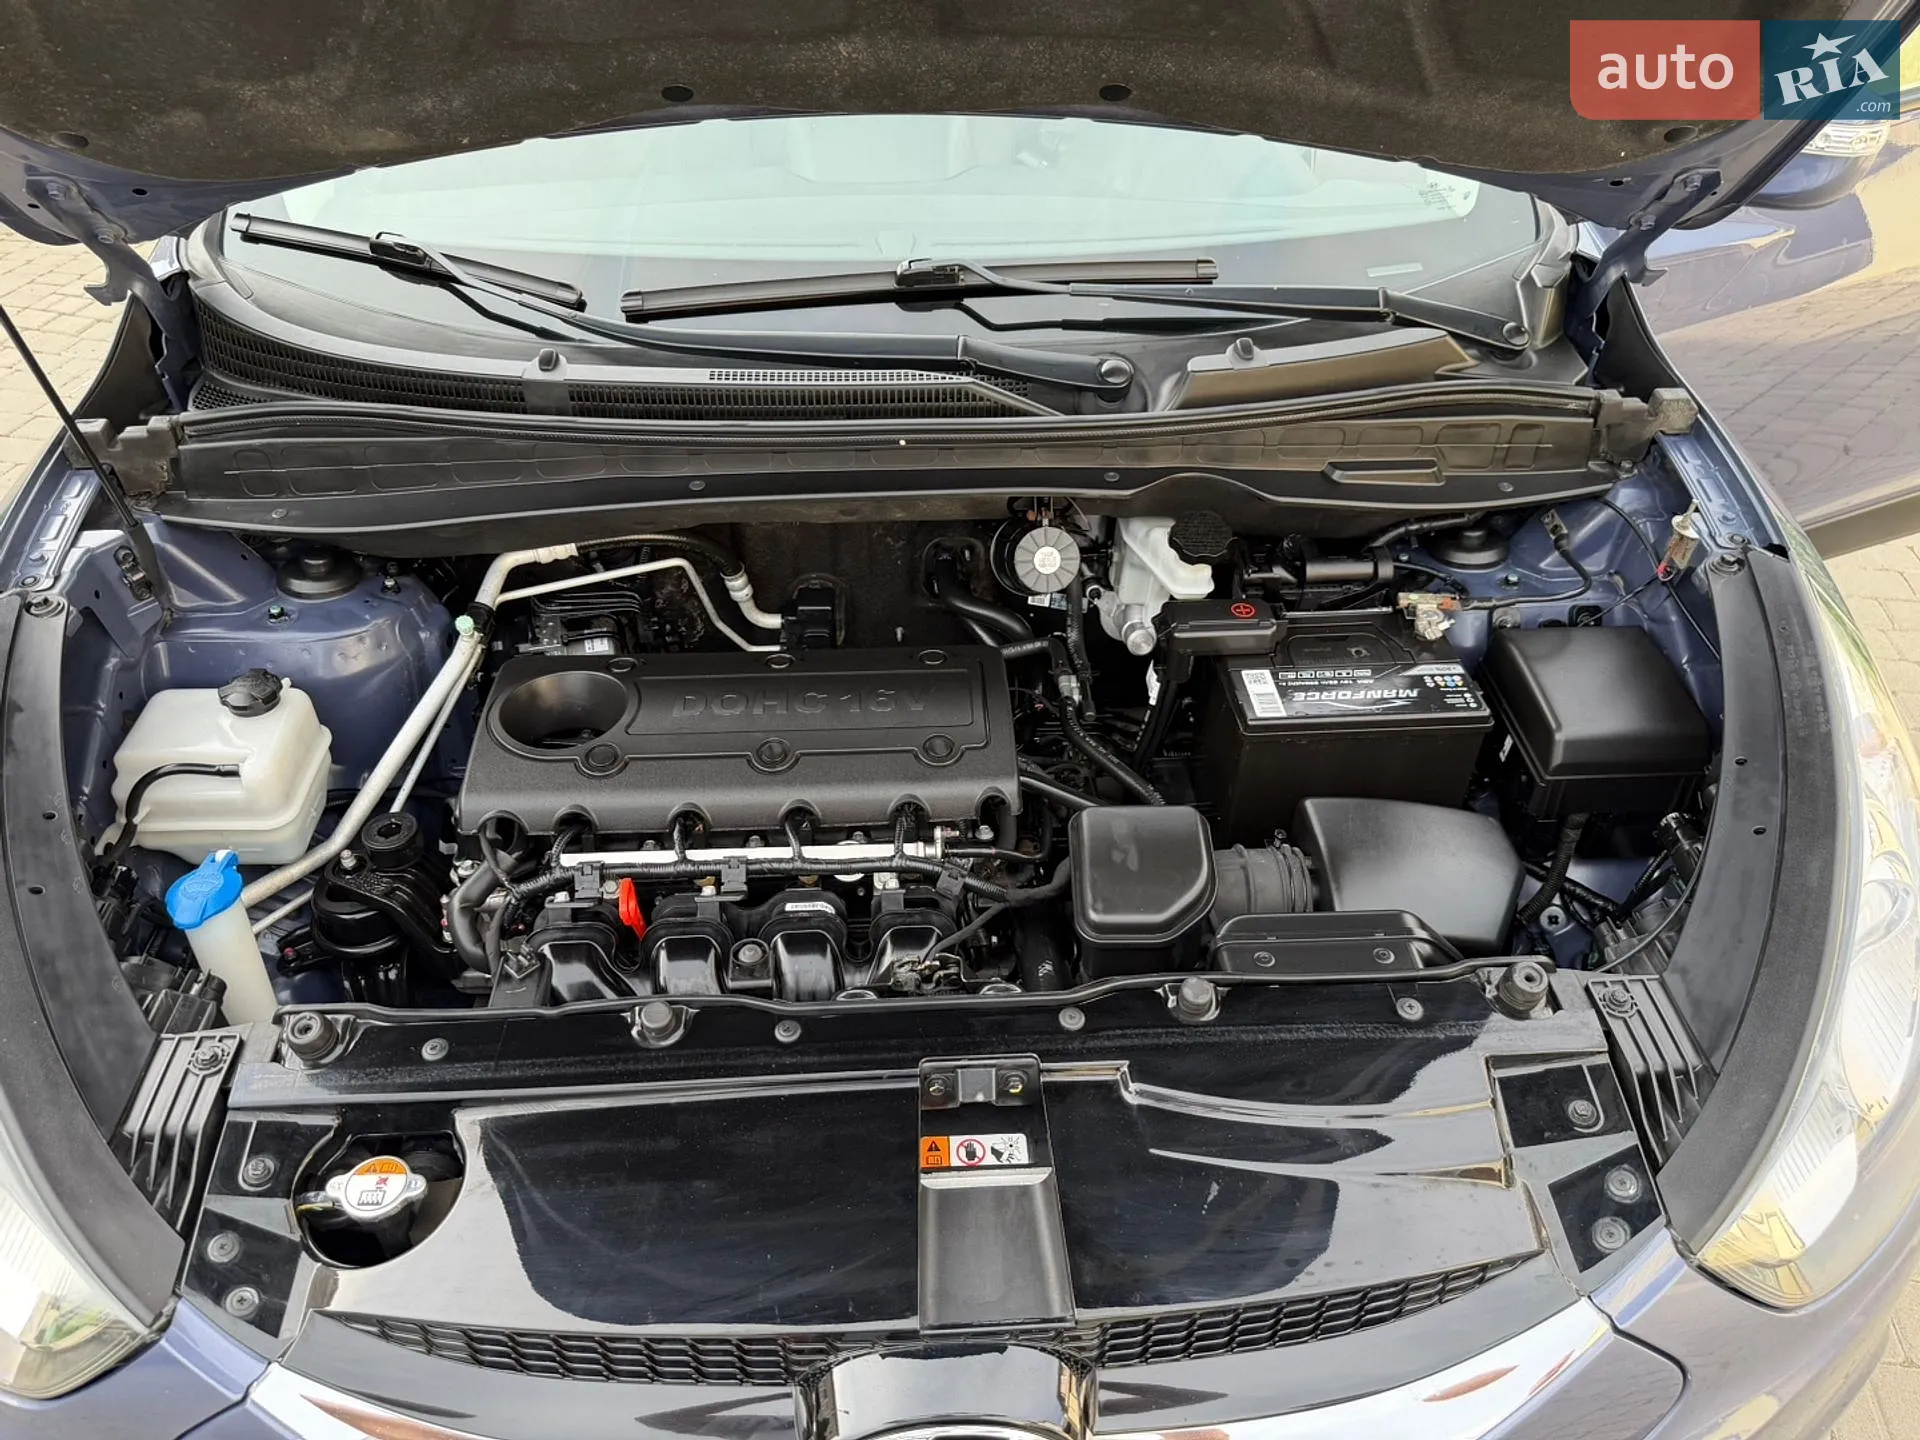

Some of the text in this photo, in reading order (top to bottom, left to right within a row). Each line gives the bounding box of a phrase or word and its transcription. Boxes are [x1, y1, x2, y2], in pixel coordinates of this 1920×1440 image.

[671, 688, 931, 717] DOHC 16V
[1292, 688, 1419, 701] MANFORCE
